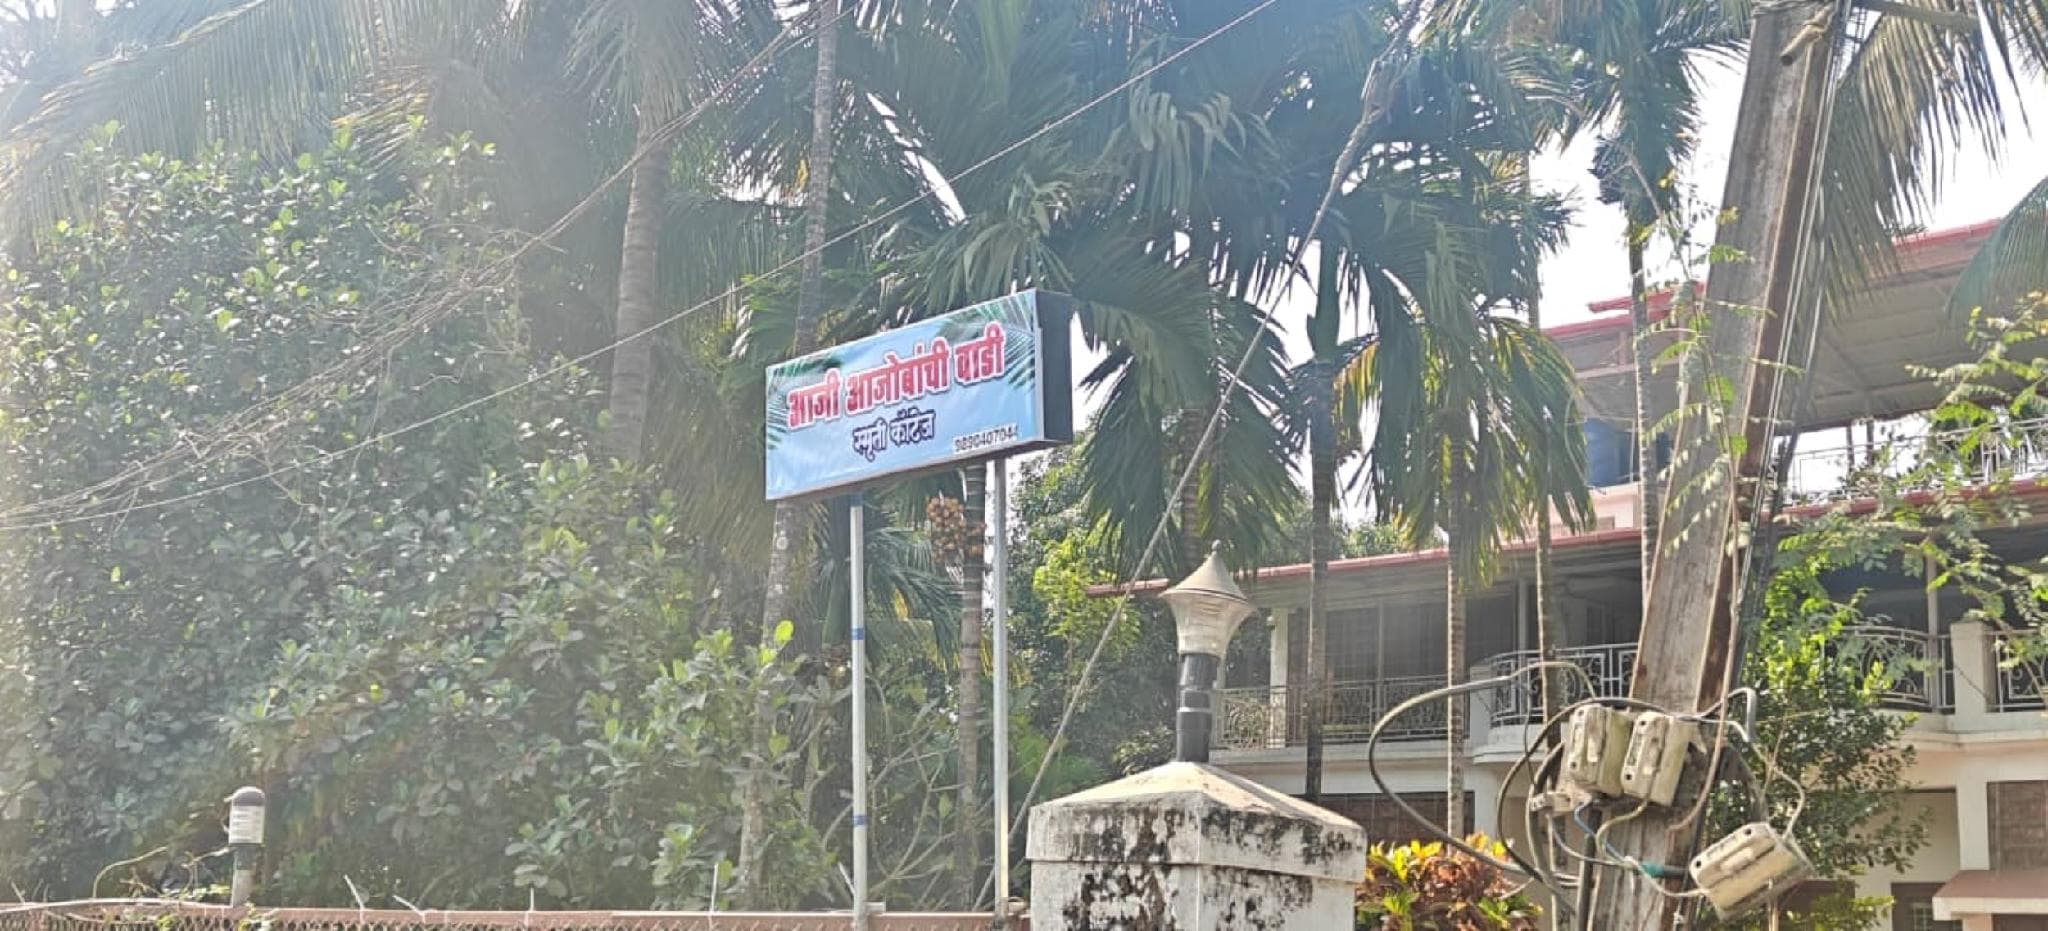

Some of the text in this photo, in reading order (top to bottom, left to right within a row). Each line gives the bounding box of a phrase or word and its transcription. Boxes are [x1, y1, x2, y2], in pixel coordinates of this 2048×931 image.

[788, 321, 1005, 428] आजी आजोबांची वाडी
